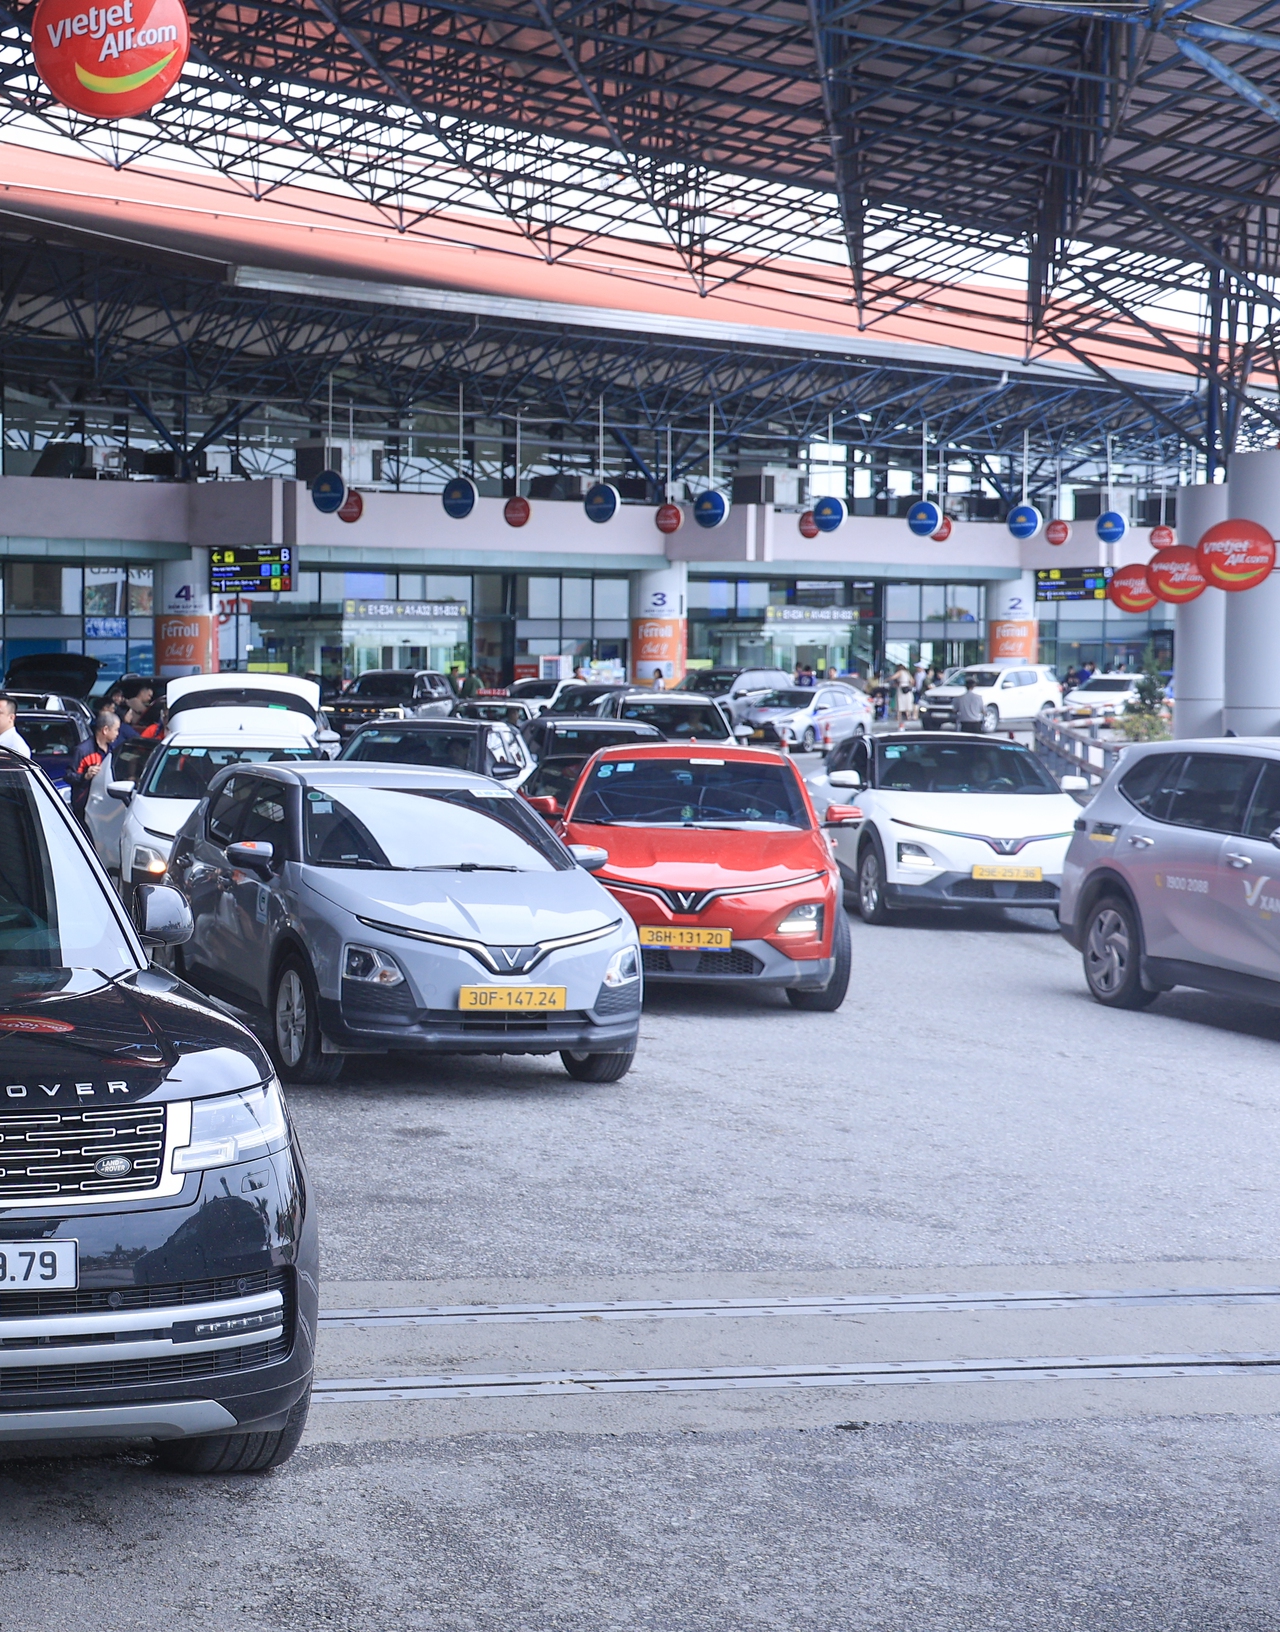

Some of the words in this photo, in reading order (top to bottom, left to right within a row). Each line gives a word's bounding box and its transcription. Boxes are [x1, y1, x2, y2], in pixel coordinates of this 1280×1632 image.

[280, 548, 290, 561] B
[175, 584, 191, 601] 4
[652, 592, 667, 606] 3
[1009, 598, 1023, 610] 2
[162, 622, 199, 640] Ferroli
[1166, 876, 1186, 891] 1900
[647, 930, 723, 945] 36H-131.20
[469, 991, 557, 1006] 30F-147.24
